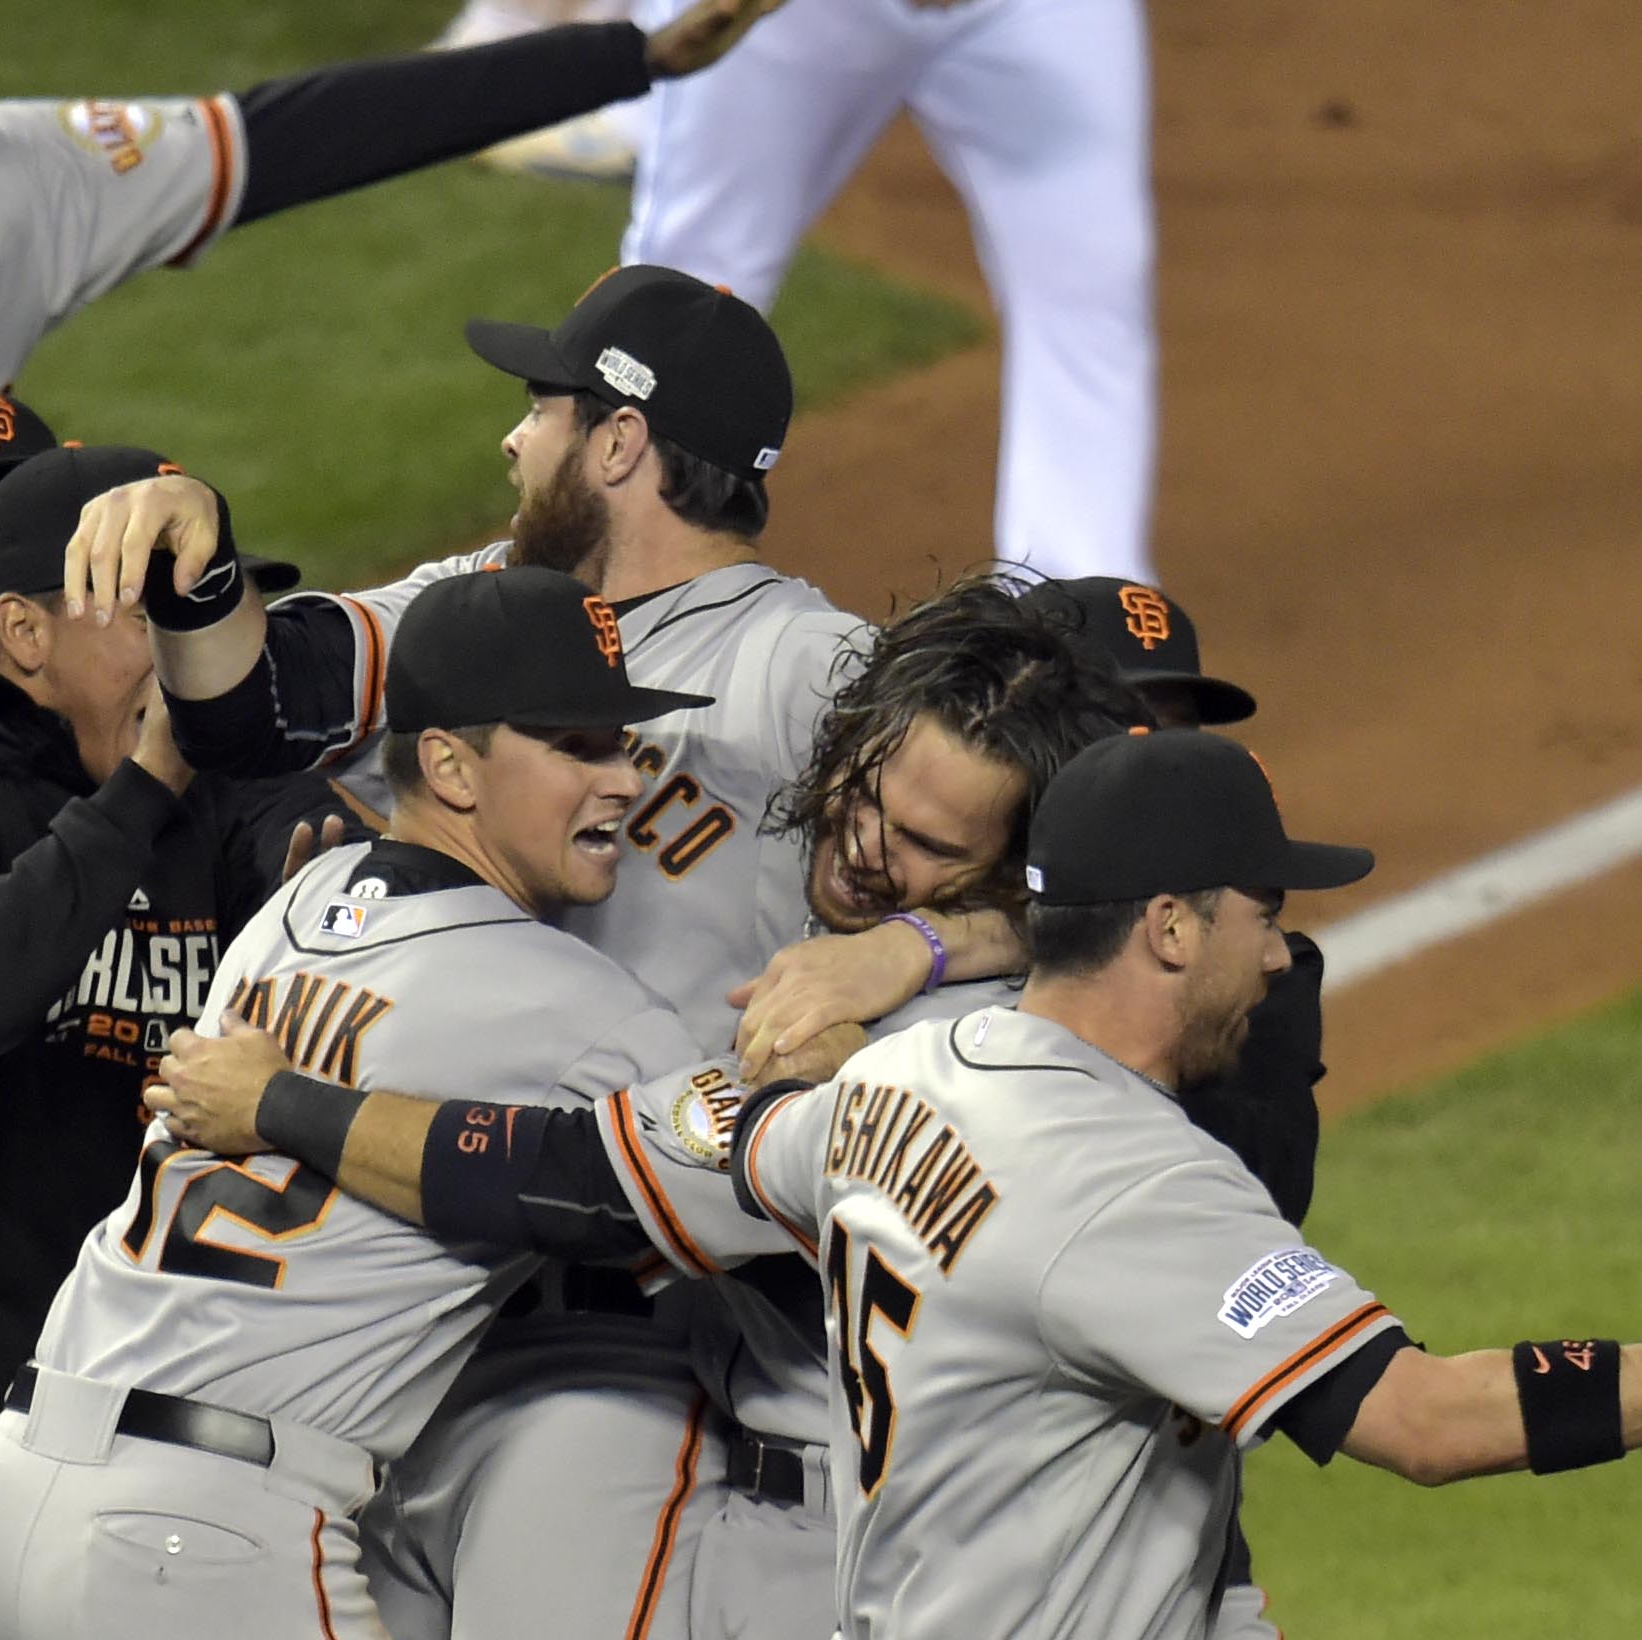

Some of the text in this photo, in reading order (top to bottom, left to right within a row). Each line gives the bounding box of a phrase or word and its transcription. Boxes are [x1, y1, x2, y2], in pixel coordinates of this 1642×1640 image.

[457, 1105, 496, 1154] 35
[690, 1067, 741, 1172] GIAN
[120, 1139, 345, 1290] 12
[823, 1080, 1002, 1277] ISHIKAWA
[1224, 1267, 1286, 1328] WORLD
